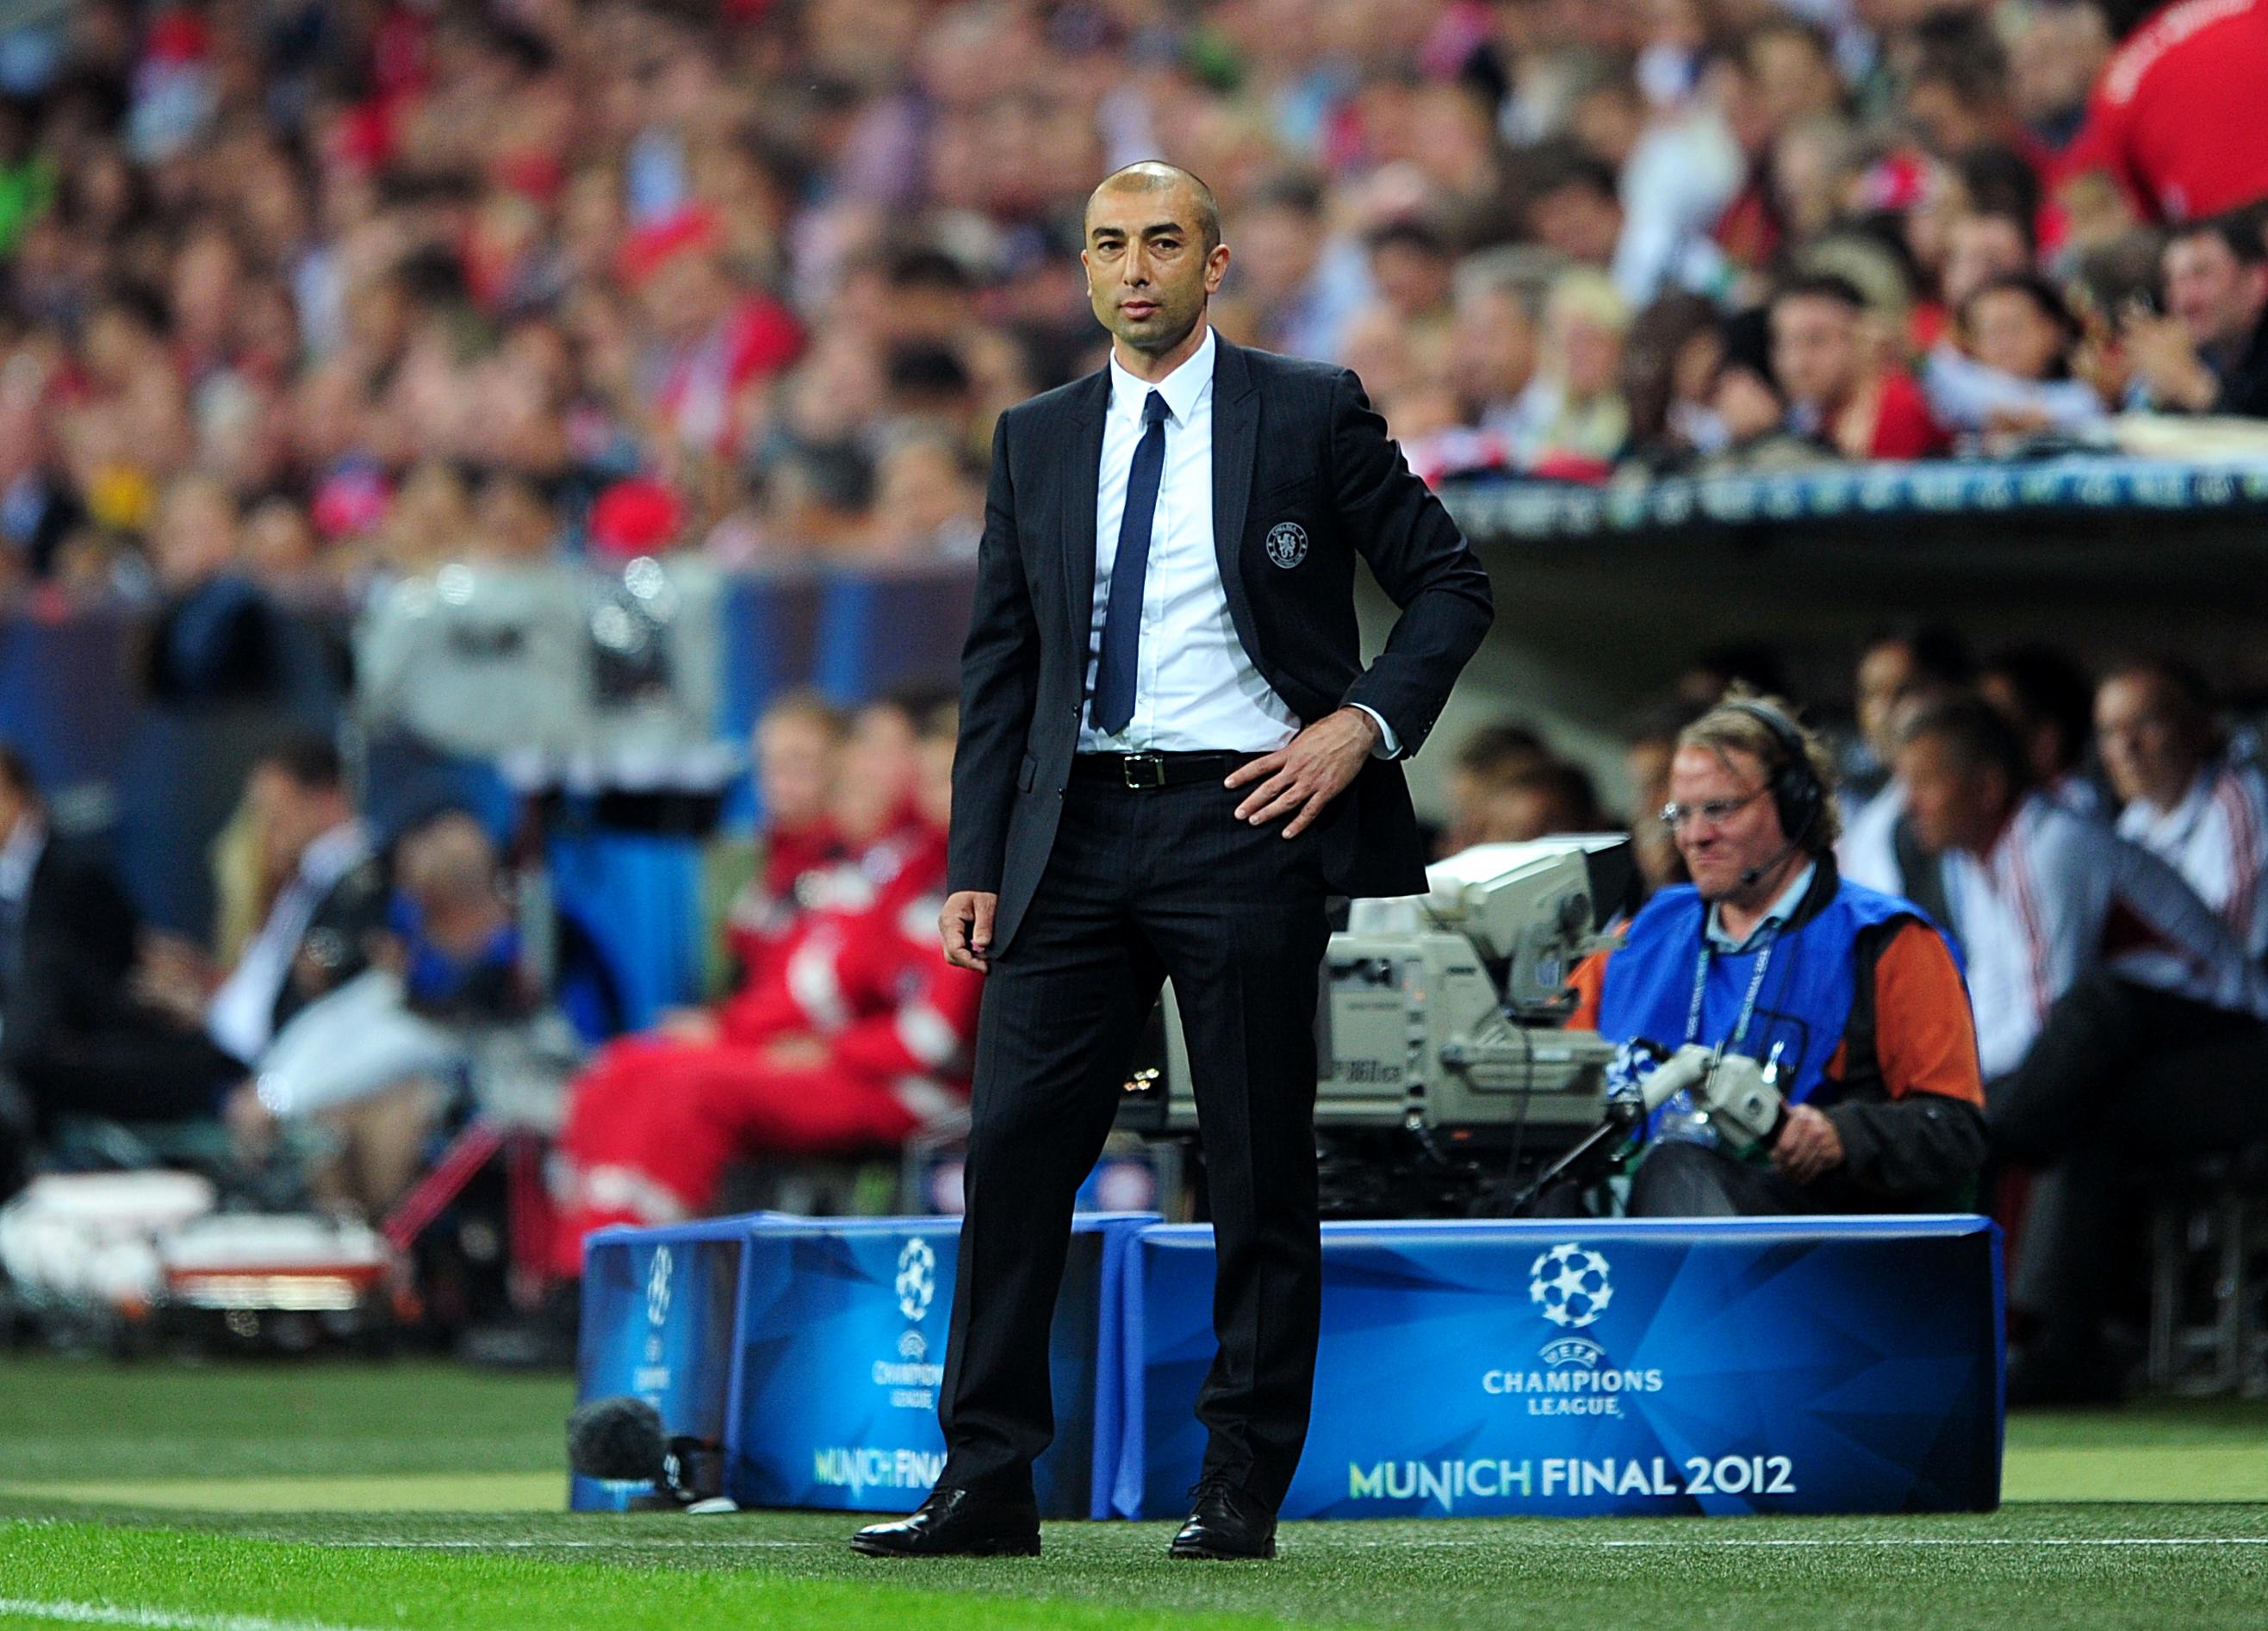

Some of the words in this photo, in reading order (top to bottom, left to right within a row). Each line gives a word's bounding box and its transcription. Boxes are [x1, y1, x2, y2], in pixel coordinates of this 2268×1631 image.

[1543, 1344, 1599, 1365] UEFA
[1482, 1369, 1663, 1394] CHAMPIONS
[1527, 1396, 1620, 1416] LEAGUE
[815, 1448, 894, 1499] MUNICH
[1349, 1460, 1532, 1511] MUNICH
[1542, 1457, 1677, 1497] FINAL
[1685, 1455, 1796, 1496] 2012
